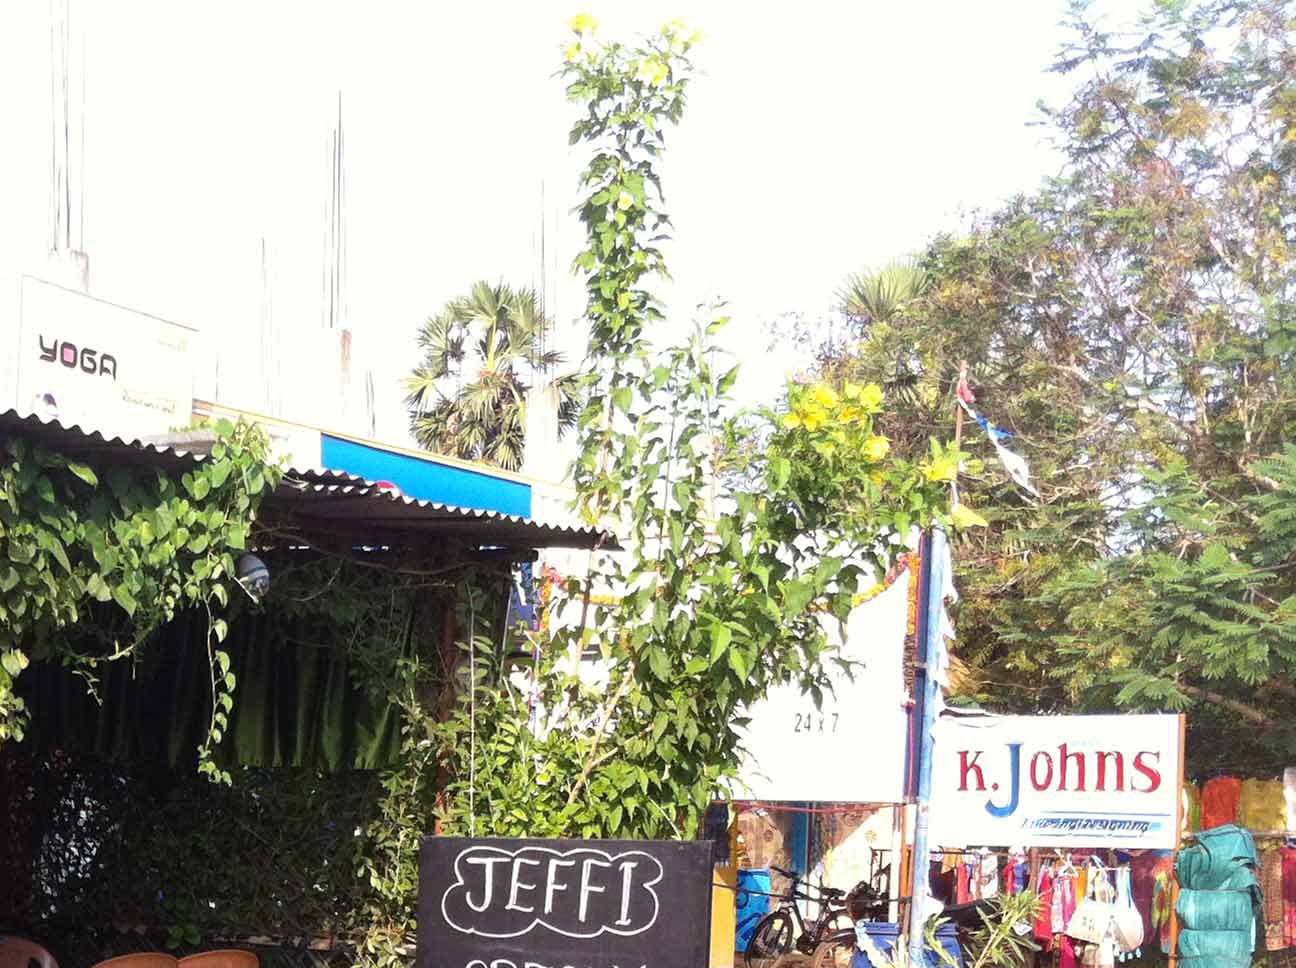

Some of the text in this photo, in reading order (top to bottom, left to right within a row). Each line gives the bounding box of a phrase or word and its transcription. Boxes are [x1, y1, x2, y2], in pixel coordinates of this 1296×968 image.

[39, 334, 117, 381] YOGA
[794, 712, 811, 733] 24
[831, 712, 839, 733] 7
[464, 856, 640, 928] JEFFI
